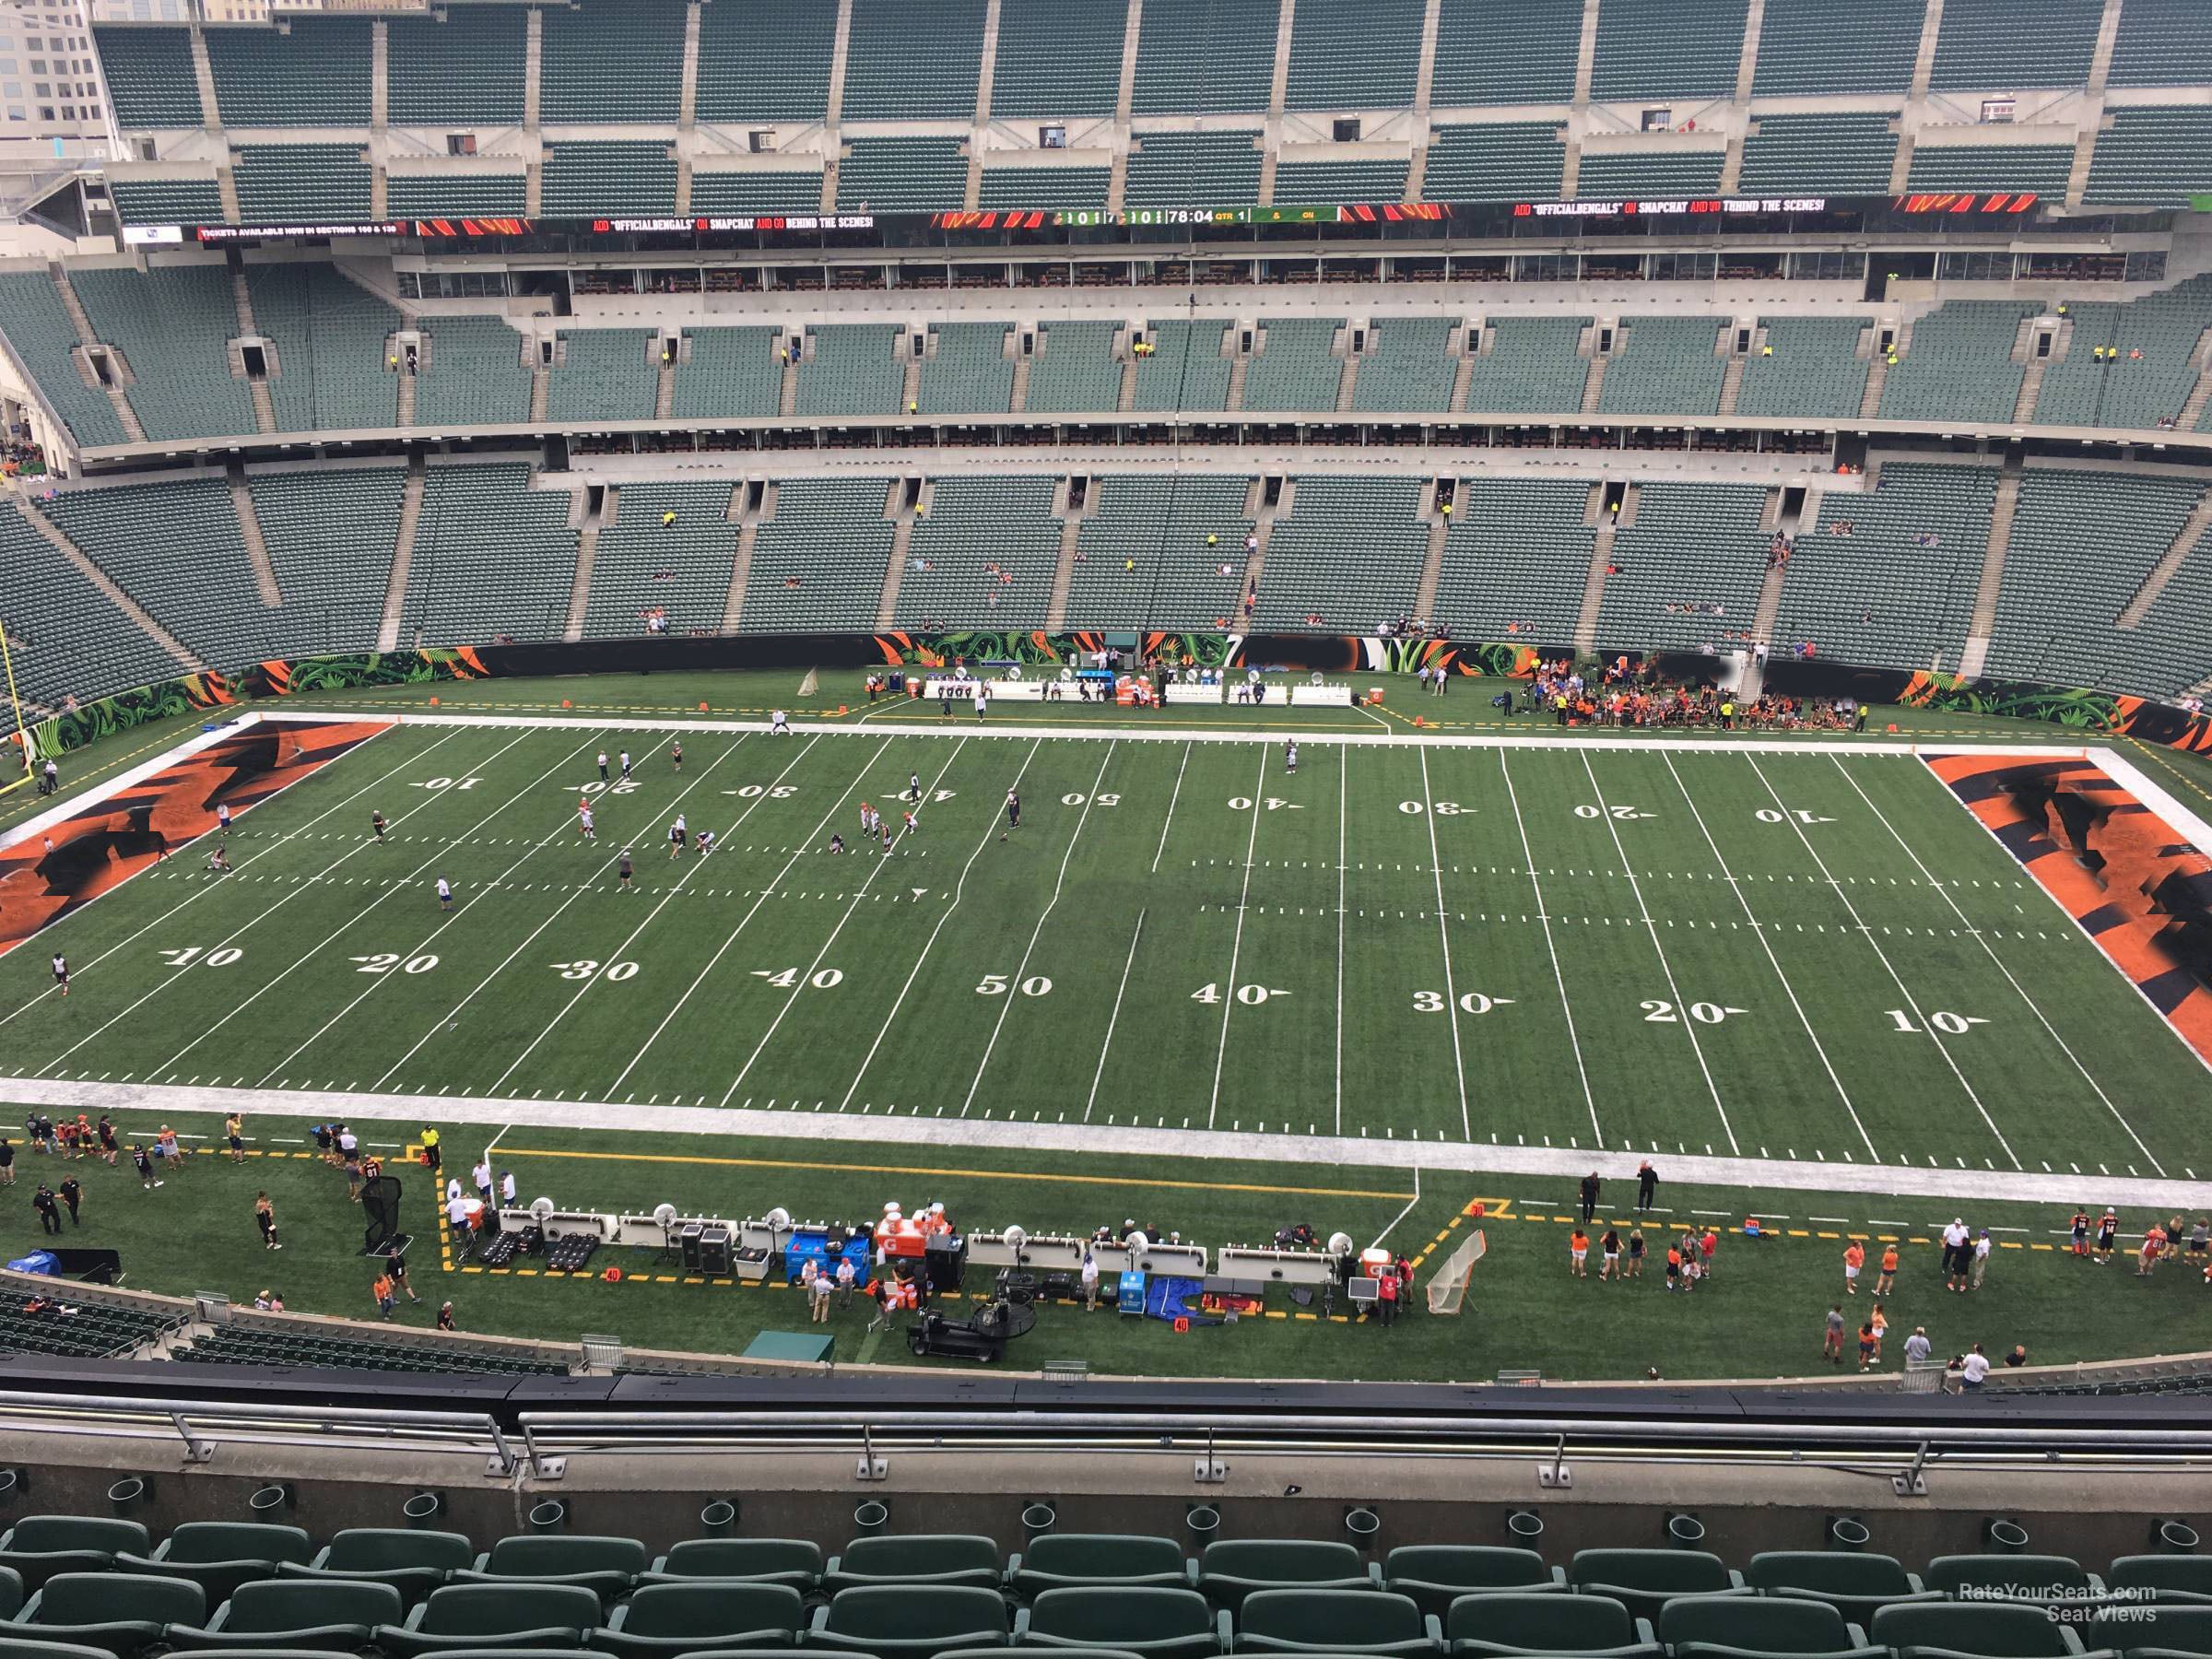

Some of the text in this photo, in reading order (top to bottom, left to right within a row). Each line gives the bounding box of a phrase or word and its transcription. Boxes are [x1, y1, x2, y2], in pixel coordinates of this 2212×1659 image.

[1169, 210, 1213, 223] 78:04
[1215, 212, 1233, 220] QTR
[1238, 211, 1245, 220] 1
[1514, 204, 1531, 216] ADD
[1624, 202, 1637, 214] ON
[1638, 202, 1688, 213] SNAPCHAT
[1690, 201, 1707, 213] AND
[1761, 200, 1781, 211] THE
[1783, 199, 1825, 211] SCENES!
[201, 229, 237, 237] TICKETS
[240, 228, 284, 236] AVAILABLE
[305, 227, 314, 235] IN
[594, 220, 609, 231] ADD
[697, 218, 708, 229] ON
[710, 218, 754, 229] SNAPCHAT
[757, 218, 771, 229] AND
[786, 218, 818, 229] BEHIND
[818, 217, 836, 229] THE
[838, 217, 874, 228] SCENES!
[1061, 793, 1122, 807] 50
[164, 947, 243, 967] 10
[357, 952, 440, 974] 20
[560, 959, 640, 981] 30
[766, 968, 843, 989] 40
[975, 974, 1053, 997] 50
[1190, 982, 1269, 1006] 40
[1413, 991, 1492, 1015] 30
[1640, 1000, 1726, 1024] 20
[1884, 1009, 1971, 1035] 10
[884, 1238, 897, 1251] G
[606, 1269, 618, 1281] 40
[1175, 1319, 1187, 1331] 40
